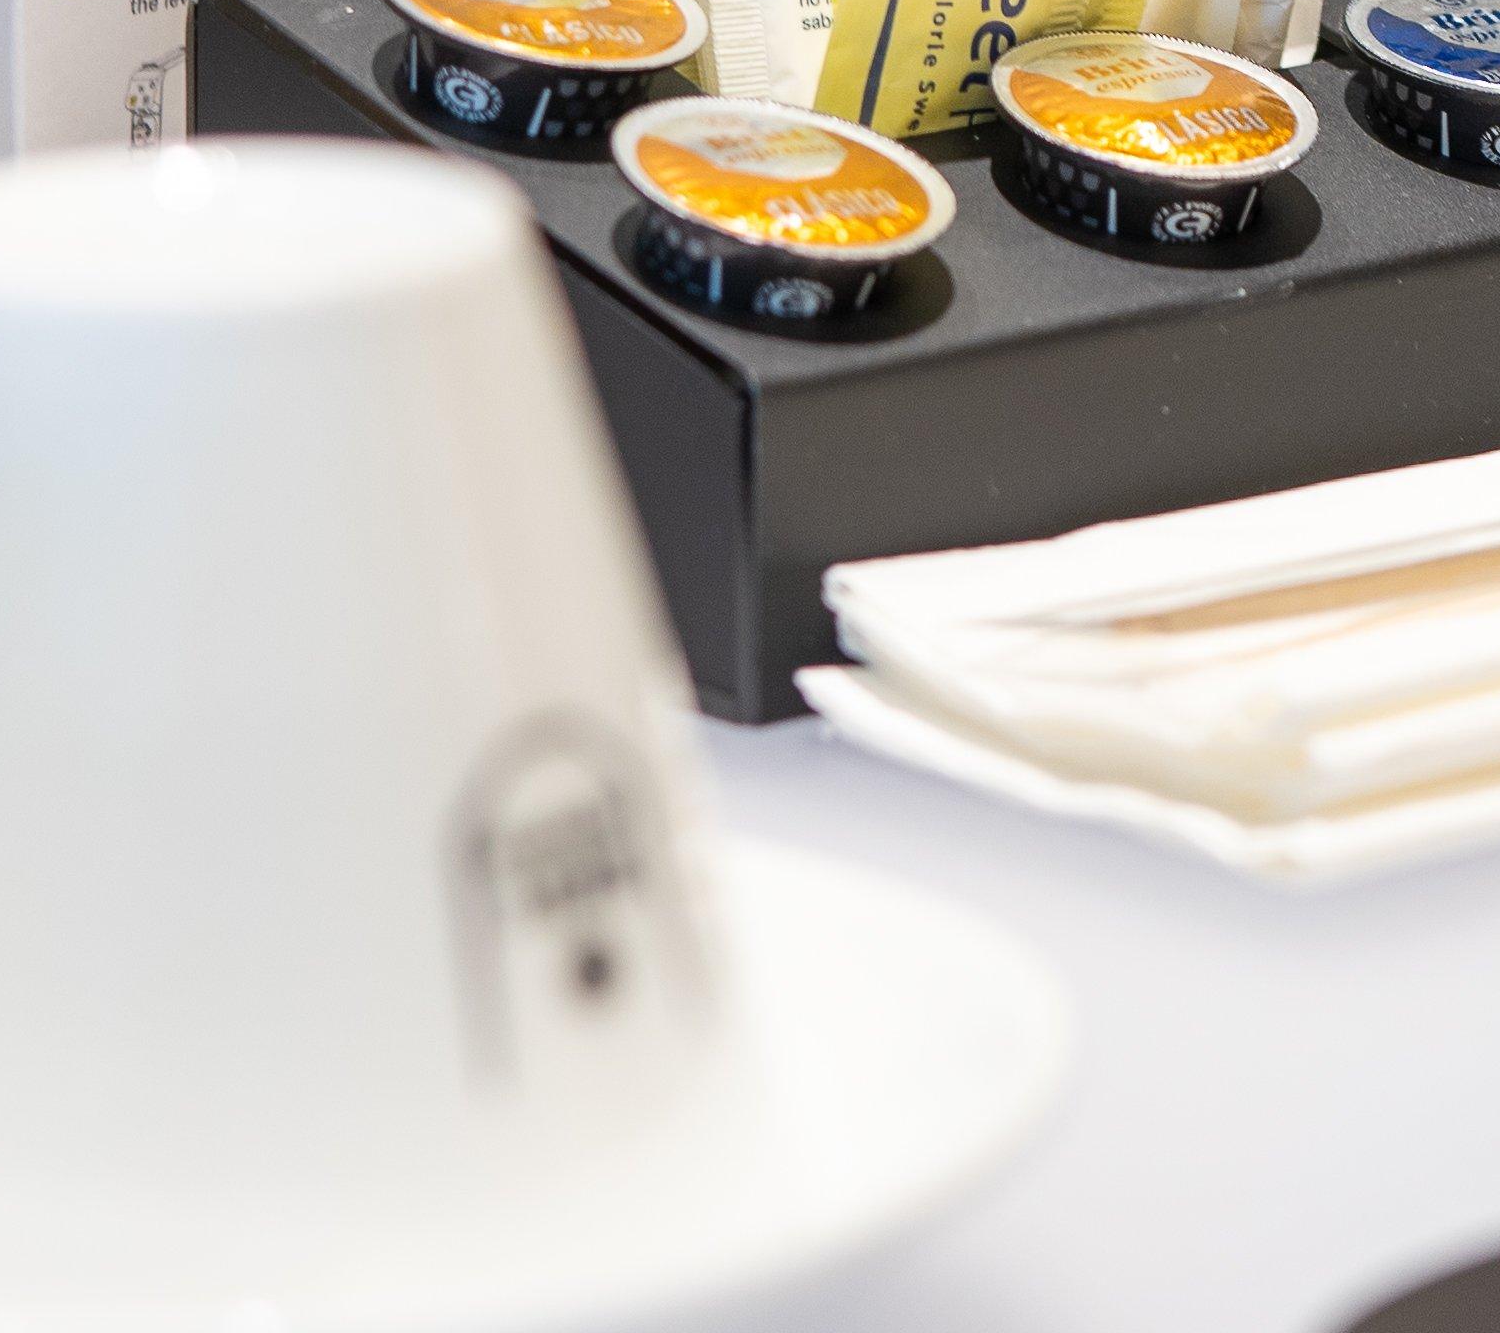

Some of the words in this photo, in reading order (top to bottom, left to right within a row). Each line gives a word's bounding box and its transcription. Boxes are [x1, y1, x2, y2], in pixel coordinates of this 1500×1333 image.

[802, 13, 833, 31] sab
[1074, 55, 1174, 81] Britt
[1096, 67, 1201, 94] espresso
[908, 79, 936, 132] Swe
[1156, 106, 1271, 146] LÁSICO
